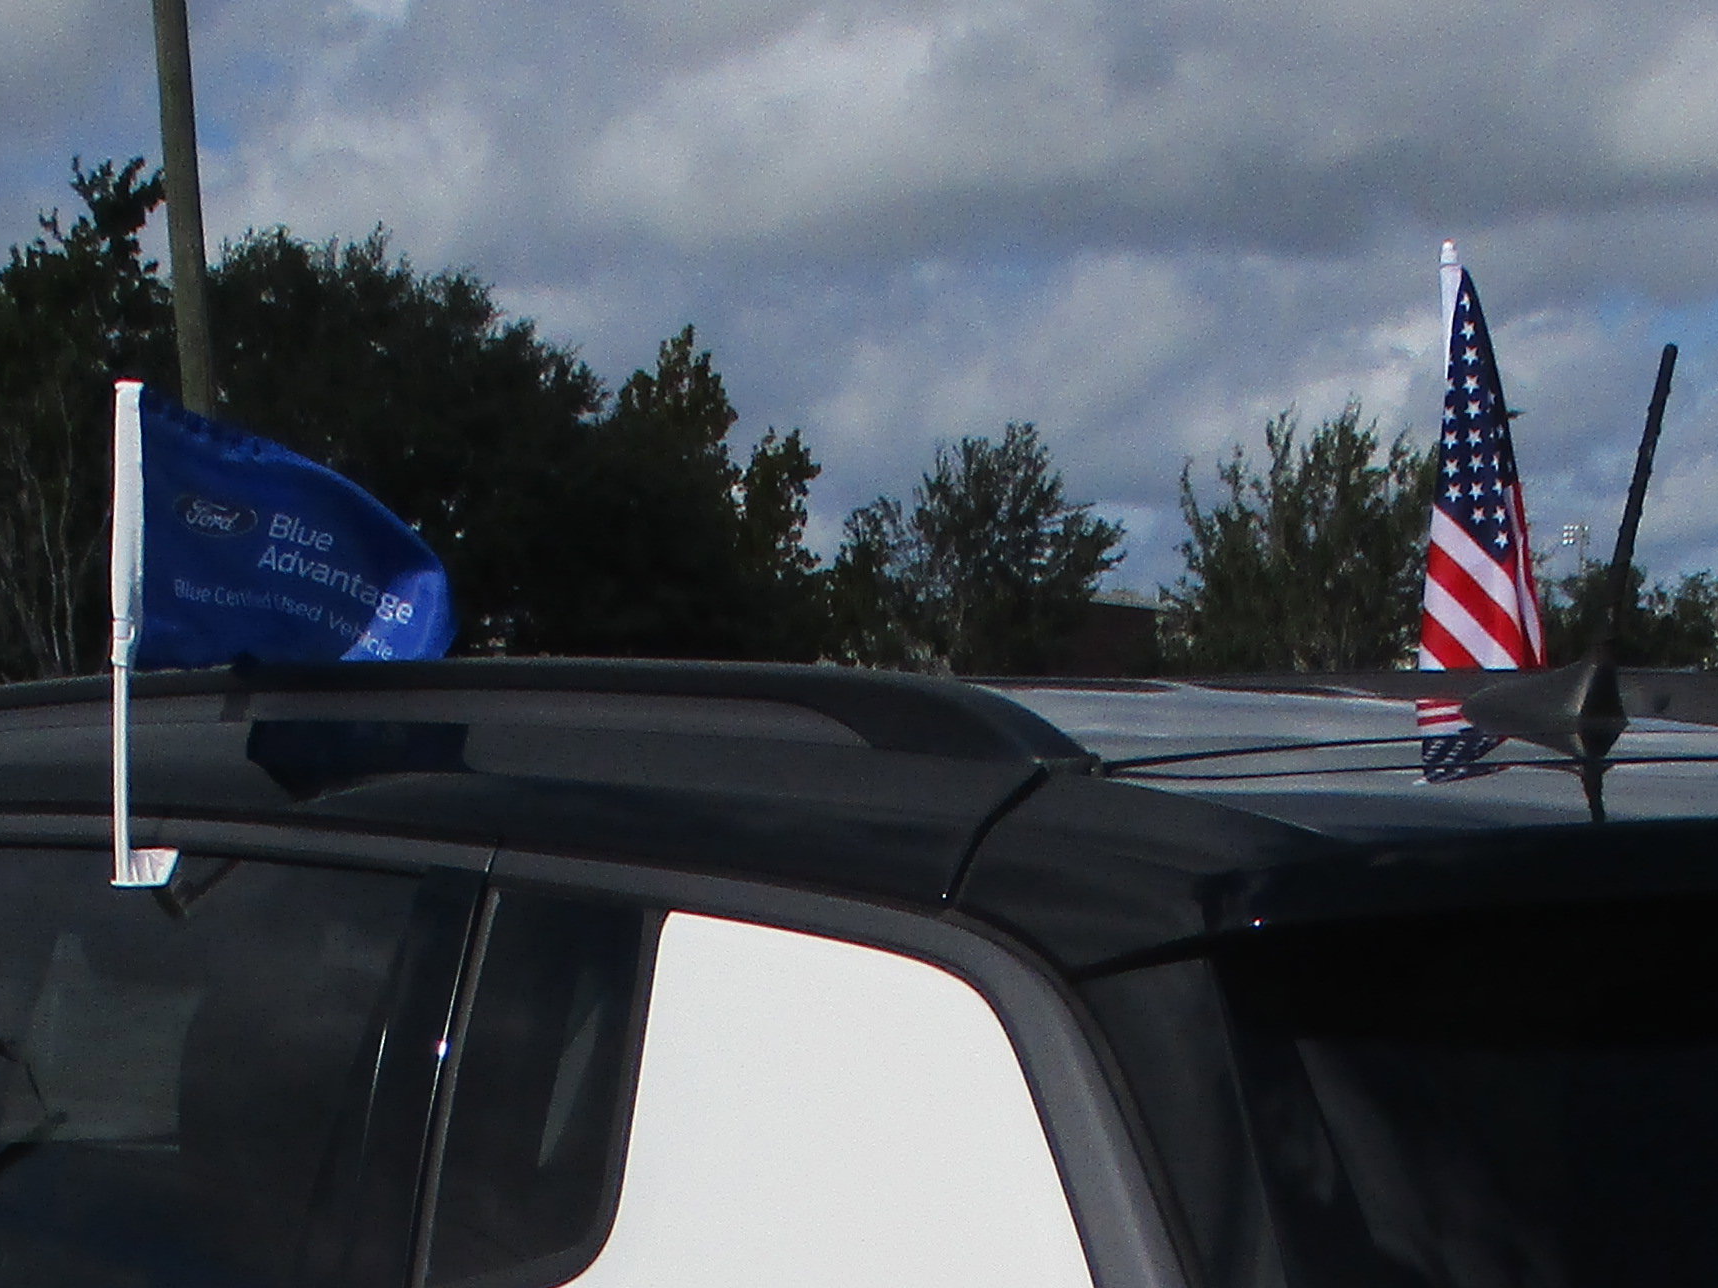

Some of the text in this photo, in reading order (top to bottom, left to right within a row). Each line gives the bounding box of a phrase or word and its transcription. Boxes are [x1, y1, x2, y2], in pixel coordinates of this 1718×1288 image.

[182, 498, 246, 533] Ford
[268, 512, 334, 551] Blue
[173, 578, 212, 603] Blue
[257, 545, 415, 625] Advantage
